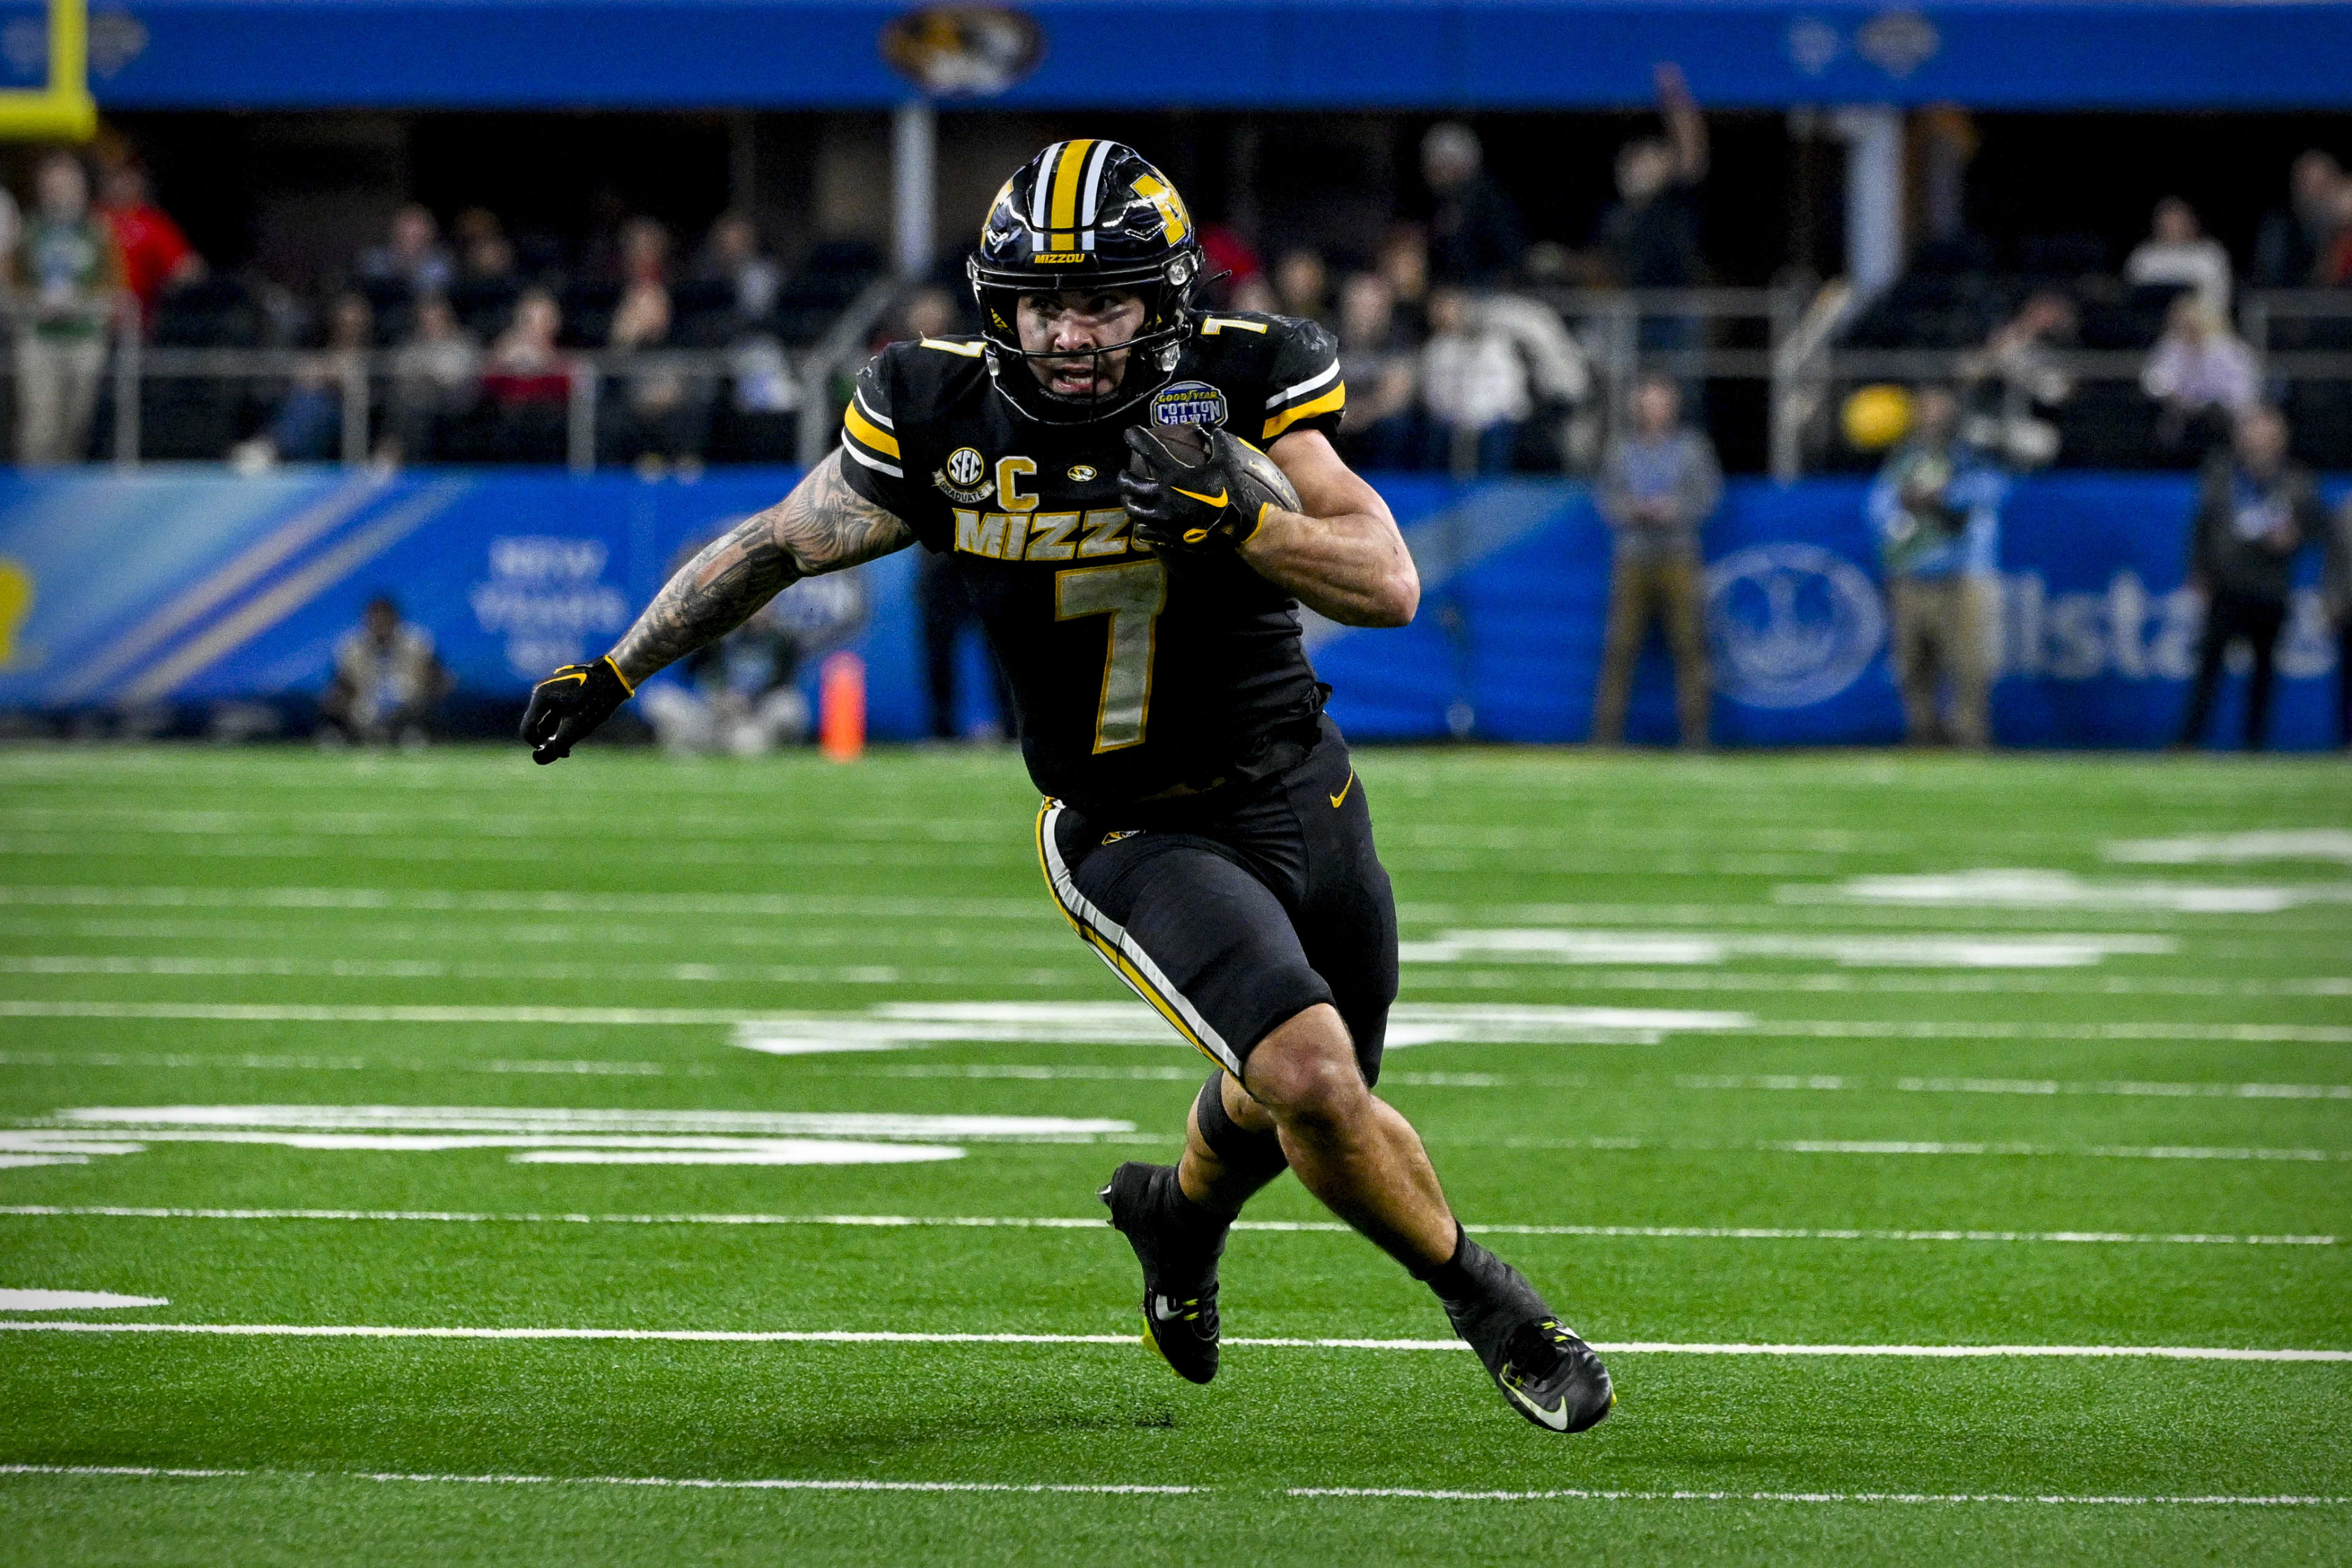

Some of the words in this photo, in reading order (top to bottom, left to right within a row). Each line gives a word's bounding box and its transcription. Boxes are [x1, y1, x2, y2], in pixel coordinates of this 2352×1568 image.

[1034, 253, 1085, 264] MIZZOU
[1157, 400, 1221, 424] COTTON
[951, 450, 981, 483] SEC
[939, 481, 986, 502] GRADUATE
[995, 456, 1040, 512] C
[952, 507, 1152, 561] MIZZ
[1055, 558, 1167, 755] 7
